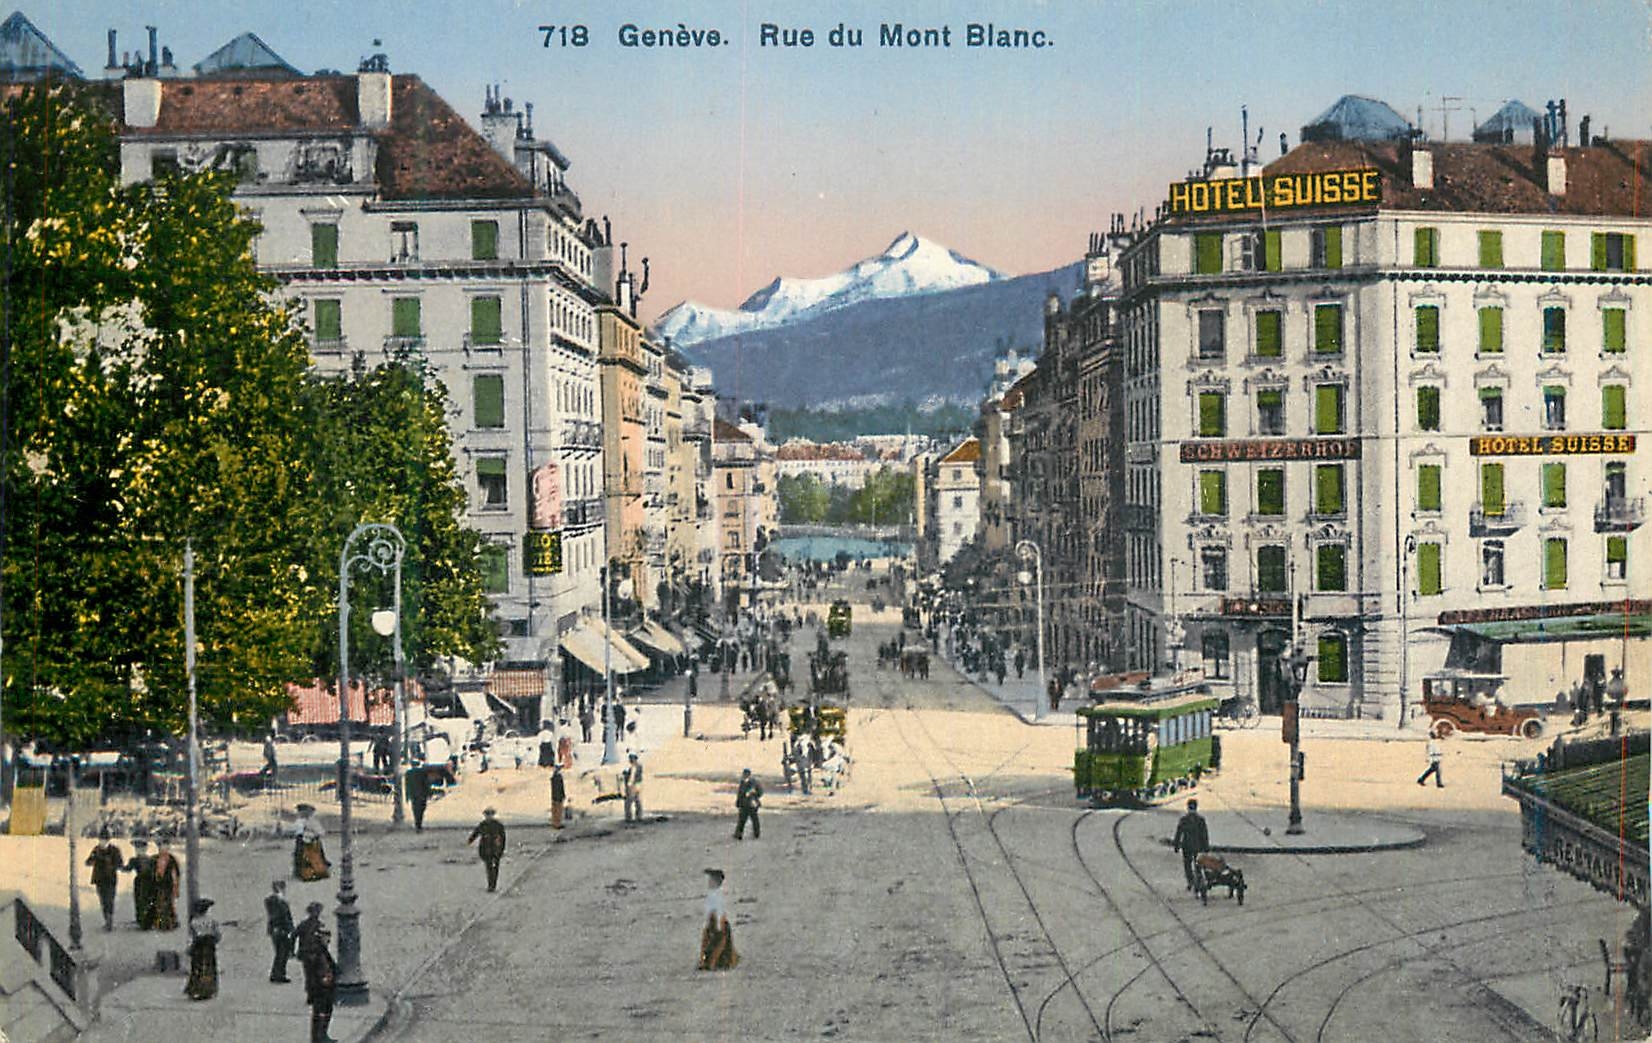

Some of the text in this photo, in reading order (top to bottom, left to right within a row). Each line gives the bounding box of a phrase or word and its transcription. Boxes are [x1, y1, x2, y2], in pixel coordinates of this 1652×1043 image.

[1172, 172, 1379, 212] HOTEL SUISSE
[1184, 441, 1356, 460] SCHWEIZERHOF
[1479, 436, 1629, 454] HOTEL SUISSE
